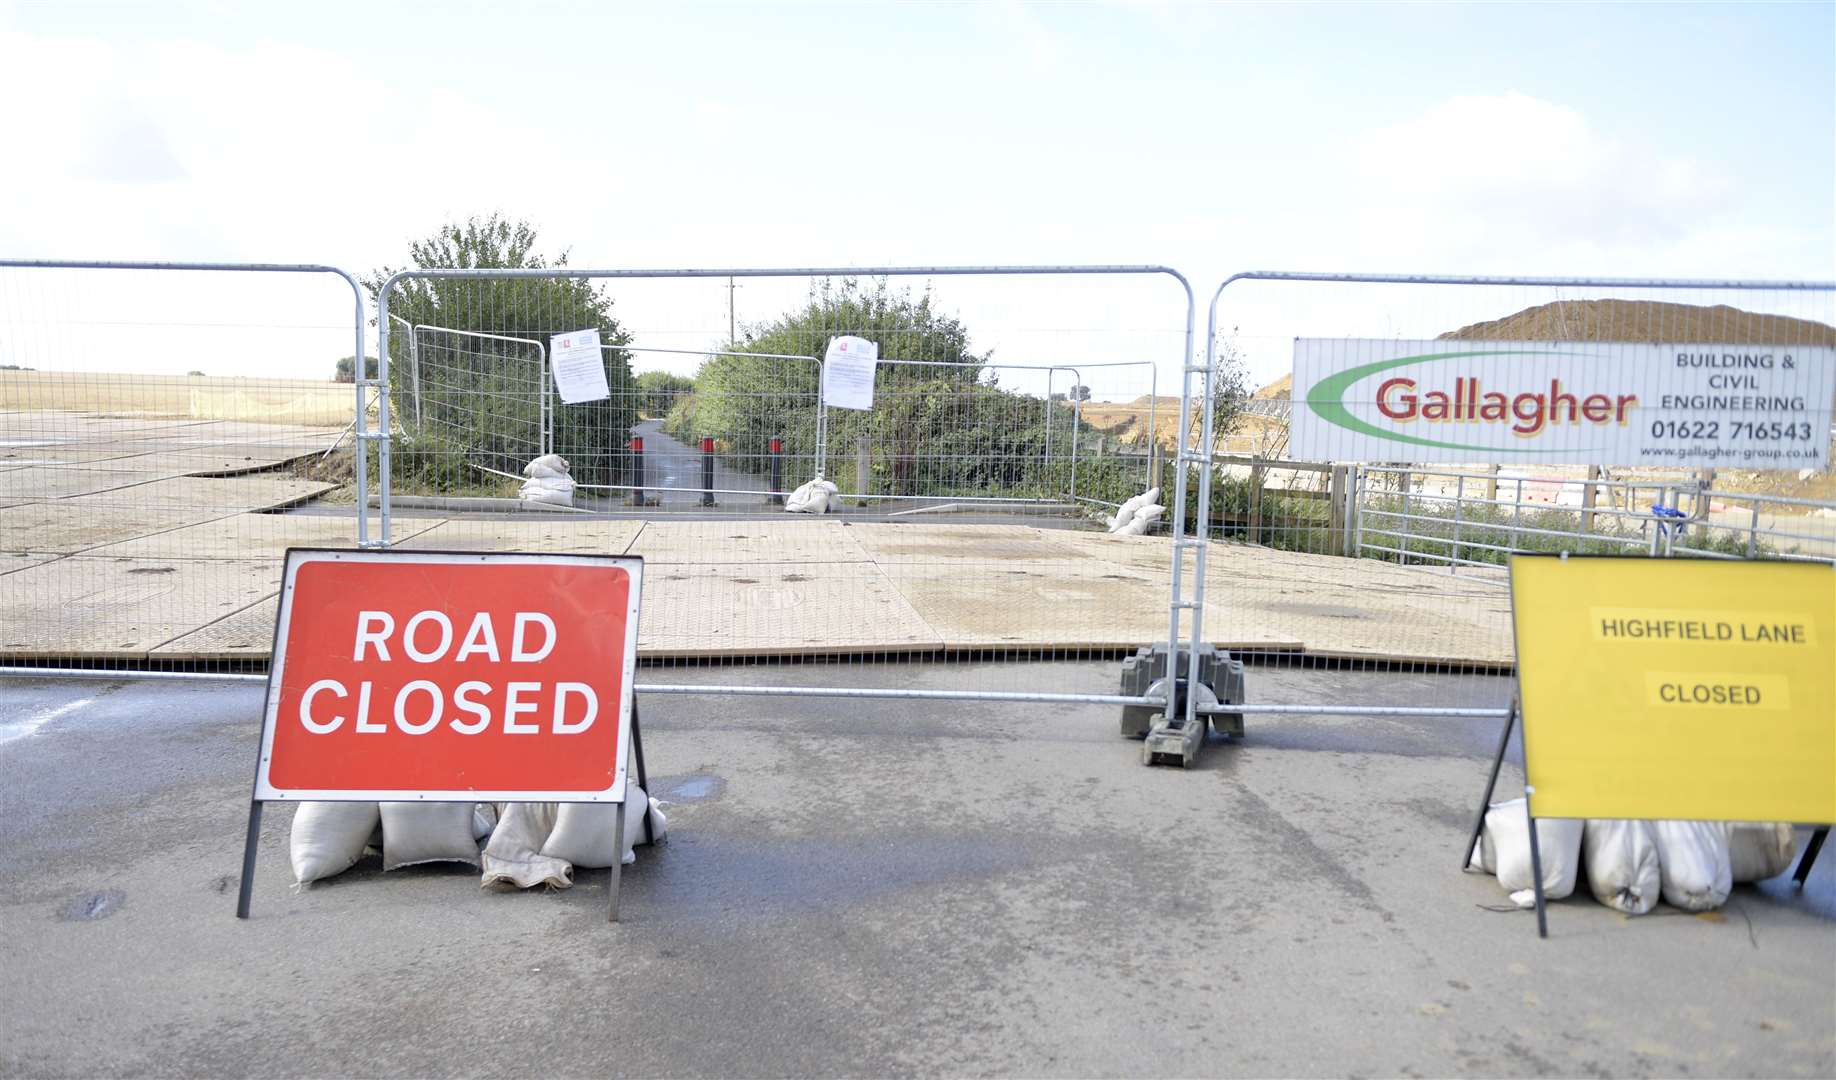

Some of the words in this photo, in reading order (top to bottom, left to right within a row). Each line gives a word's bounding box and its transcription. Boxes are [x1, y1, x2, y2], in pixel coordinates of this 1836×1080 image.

[1677, 353, 1774, 369] BUILDING
[1781, 354, 1795, 369] &
[1708, 374, 1759, 390] CIVIL
[1375, 377, 1639, 437] Gallagher
[1661, 395, 1805, 411] ENGINEERING
[1651, 420, 1719, 439] 01622
[1730, 422, 1812, 441] 716543
[1640, 447, 1819, 460] www.gallagher-group.co.uk
[353, 610, 557, 663] ROAD
[1601, 618, 1733, 641] HIGHFIELD
[1741, 623, 1806, 644] LANE
[1659, 683, 1761, 705] CLOSED
[299, 679, 599, 735] CLOSED
